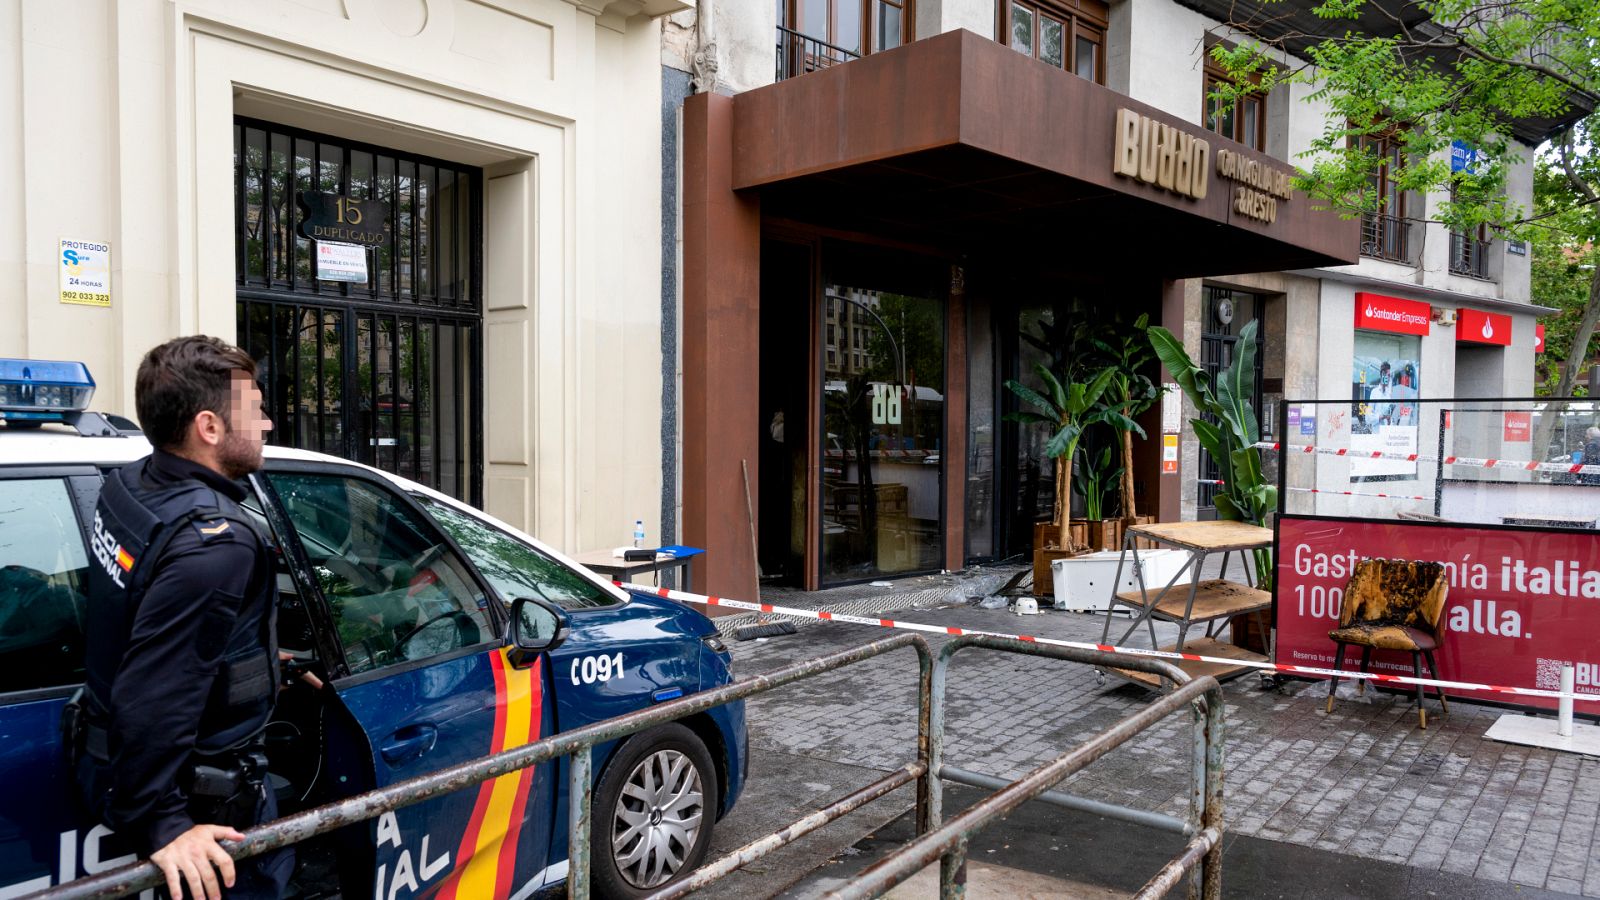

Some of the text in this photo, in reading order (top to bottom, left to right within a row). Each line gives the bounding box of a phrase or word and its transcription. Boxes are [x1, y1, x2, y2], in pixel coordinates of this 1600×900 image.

[1114, 107, 1209, 200] BURRO
[1217, 149, 1272, 191] CANAGLIA
[335, 197, 363, 226] 15
[1235, 186, 1277, 224] &RESTO
[314, 226, 384, 242] DUPLICADO
[61, 240, 108, 253] PROTEGIDO
[69, 277, 80, 286] 24
[62, 291, 77, 299] 902
[79, 292, 93, 300] 033
[95, 294, 110, 302] 323
[1294, 543, 1600, 599] Gastmía italia
[581, 652, 625, 684] 091
[1293, 650, 1318, 662] Reserva
[1318, 653, 1326, 662] tu
[1345, 657, 1353, 665] en
